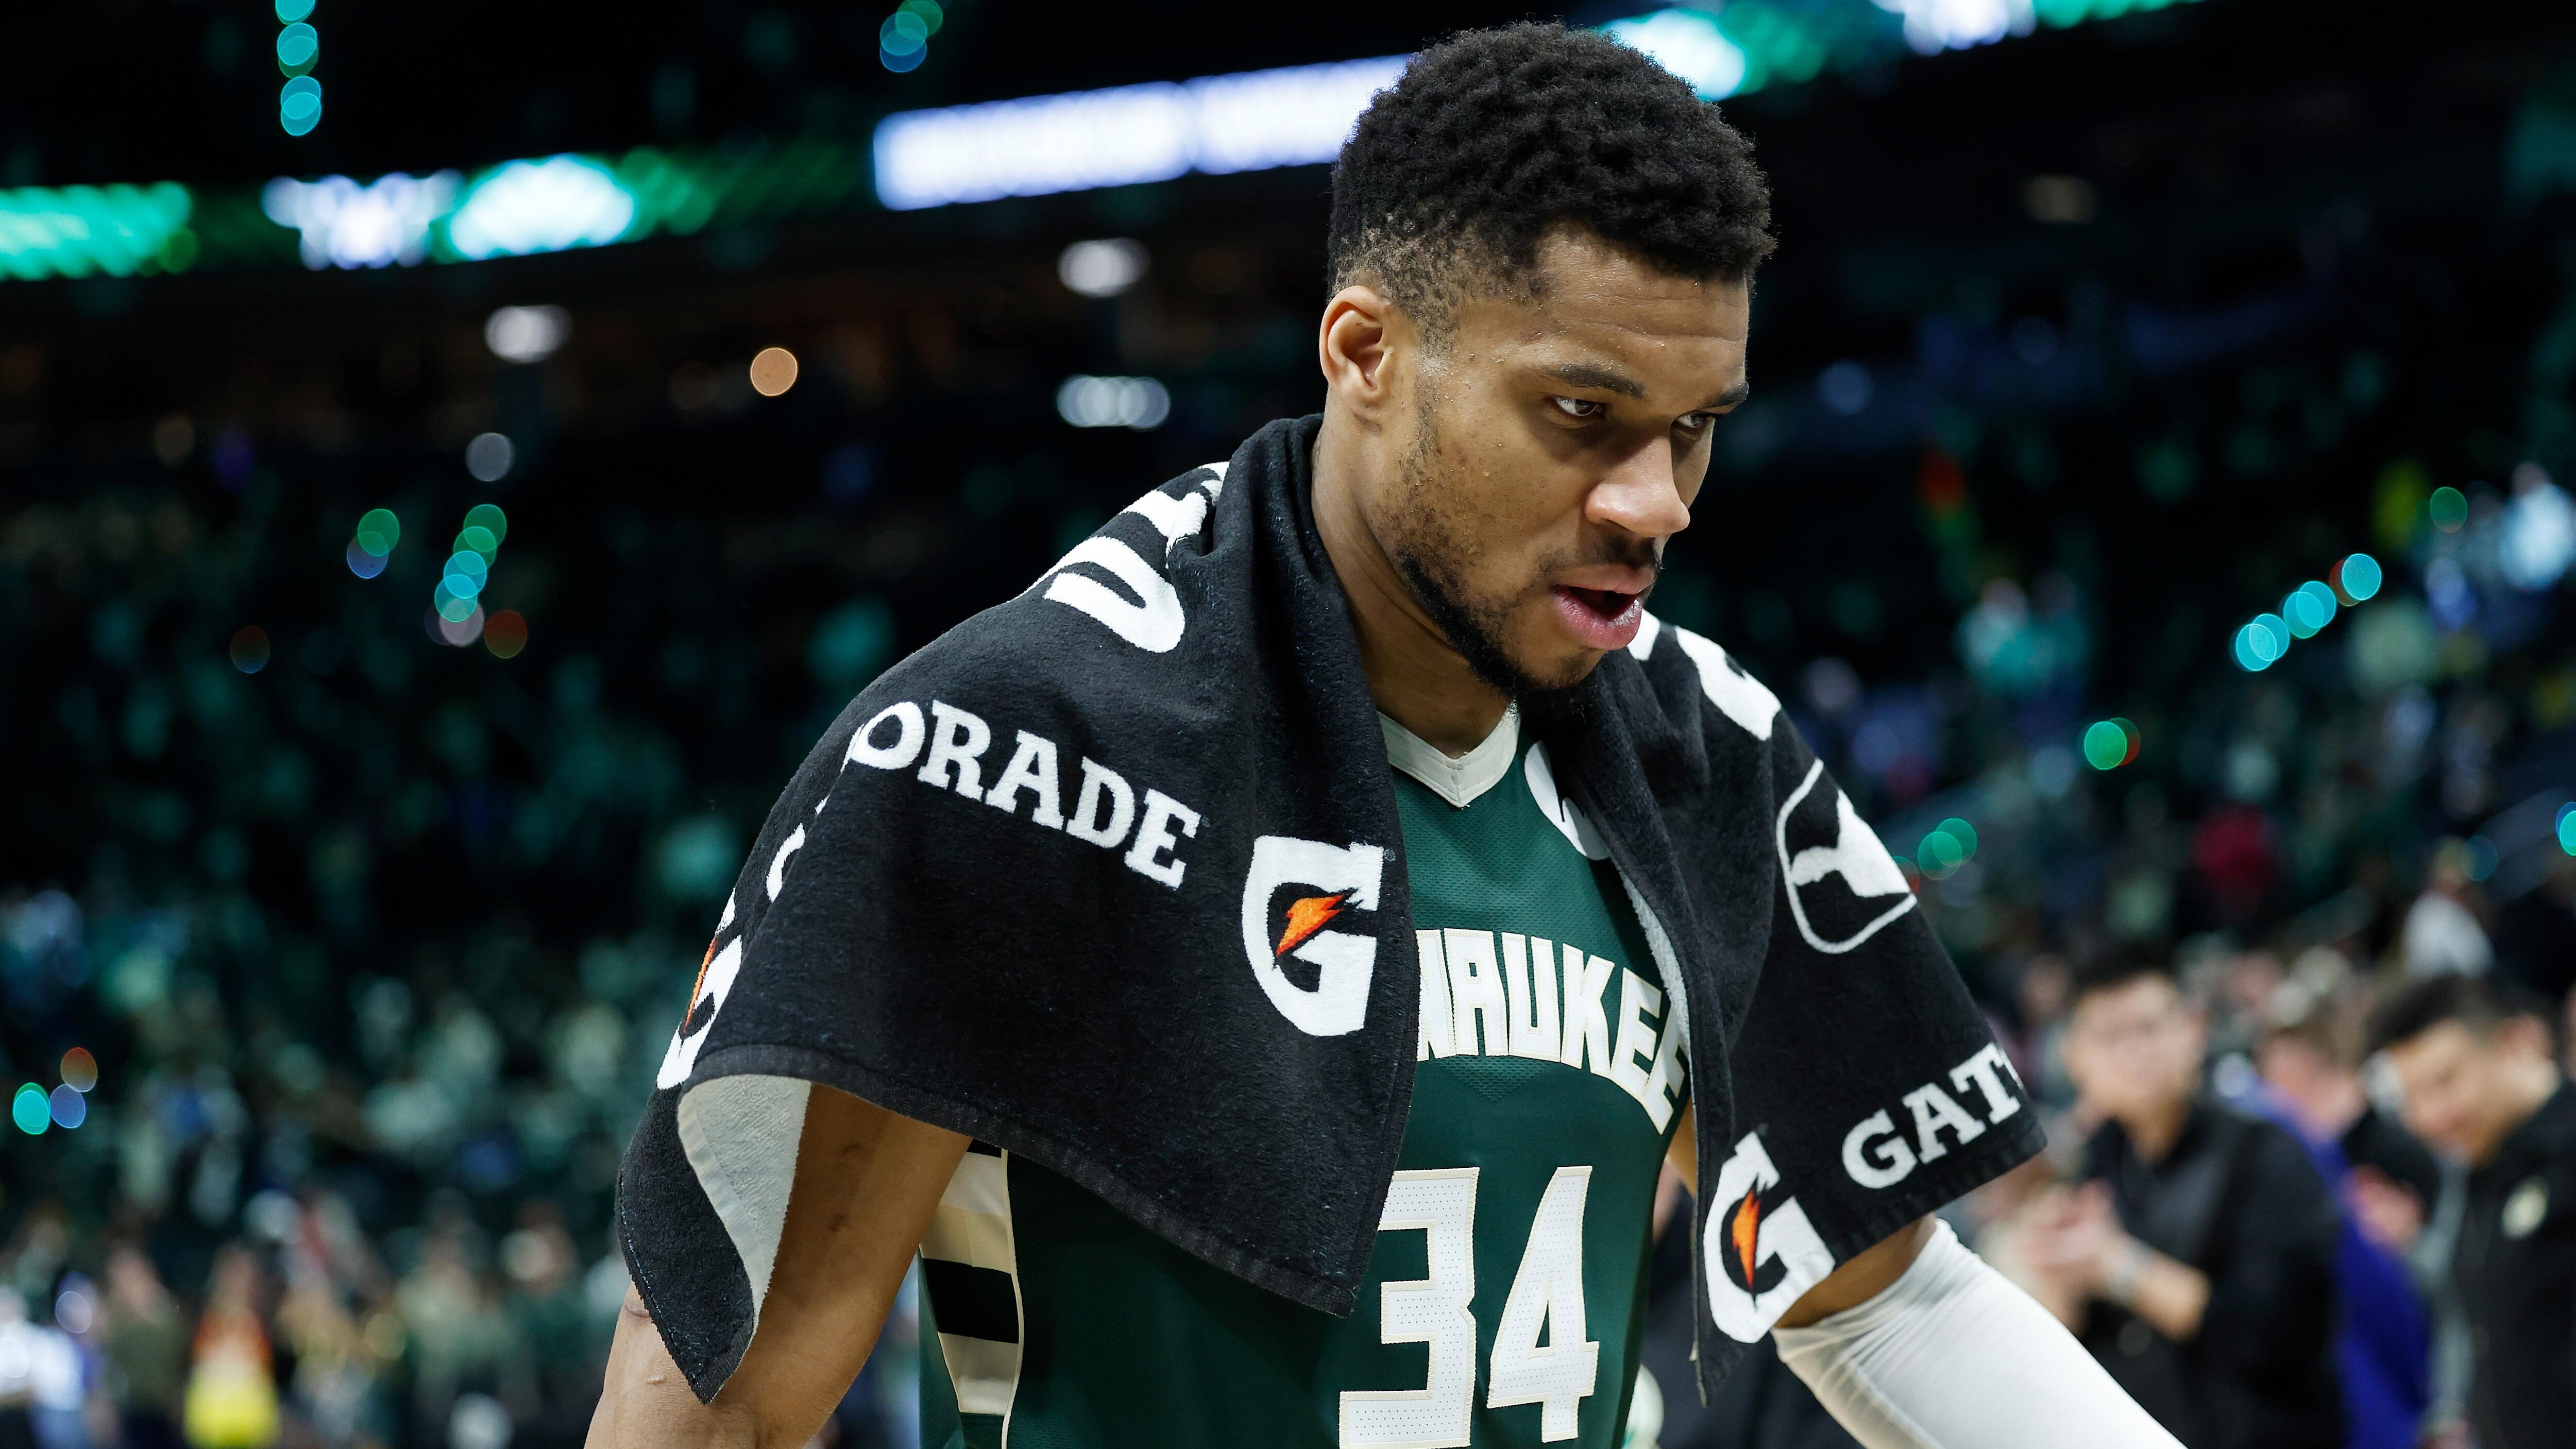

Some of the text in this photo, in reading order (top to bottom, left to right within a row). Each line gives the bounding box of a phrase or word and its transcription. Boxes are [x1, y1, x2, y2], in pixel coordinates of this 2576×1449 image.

[767, 699, 1201, 901] ORADE
[1241, 834, 1384, 1036] G
[1340, 1165, 1599, 1447] 34
[1703, 1131, 1836, 1344] G
